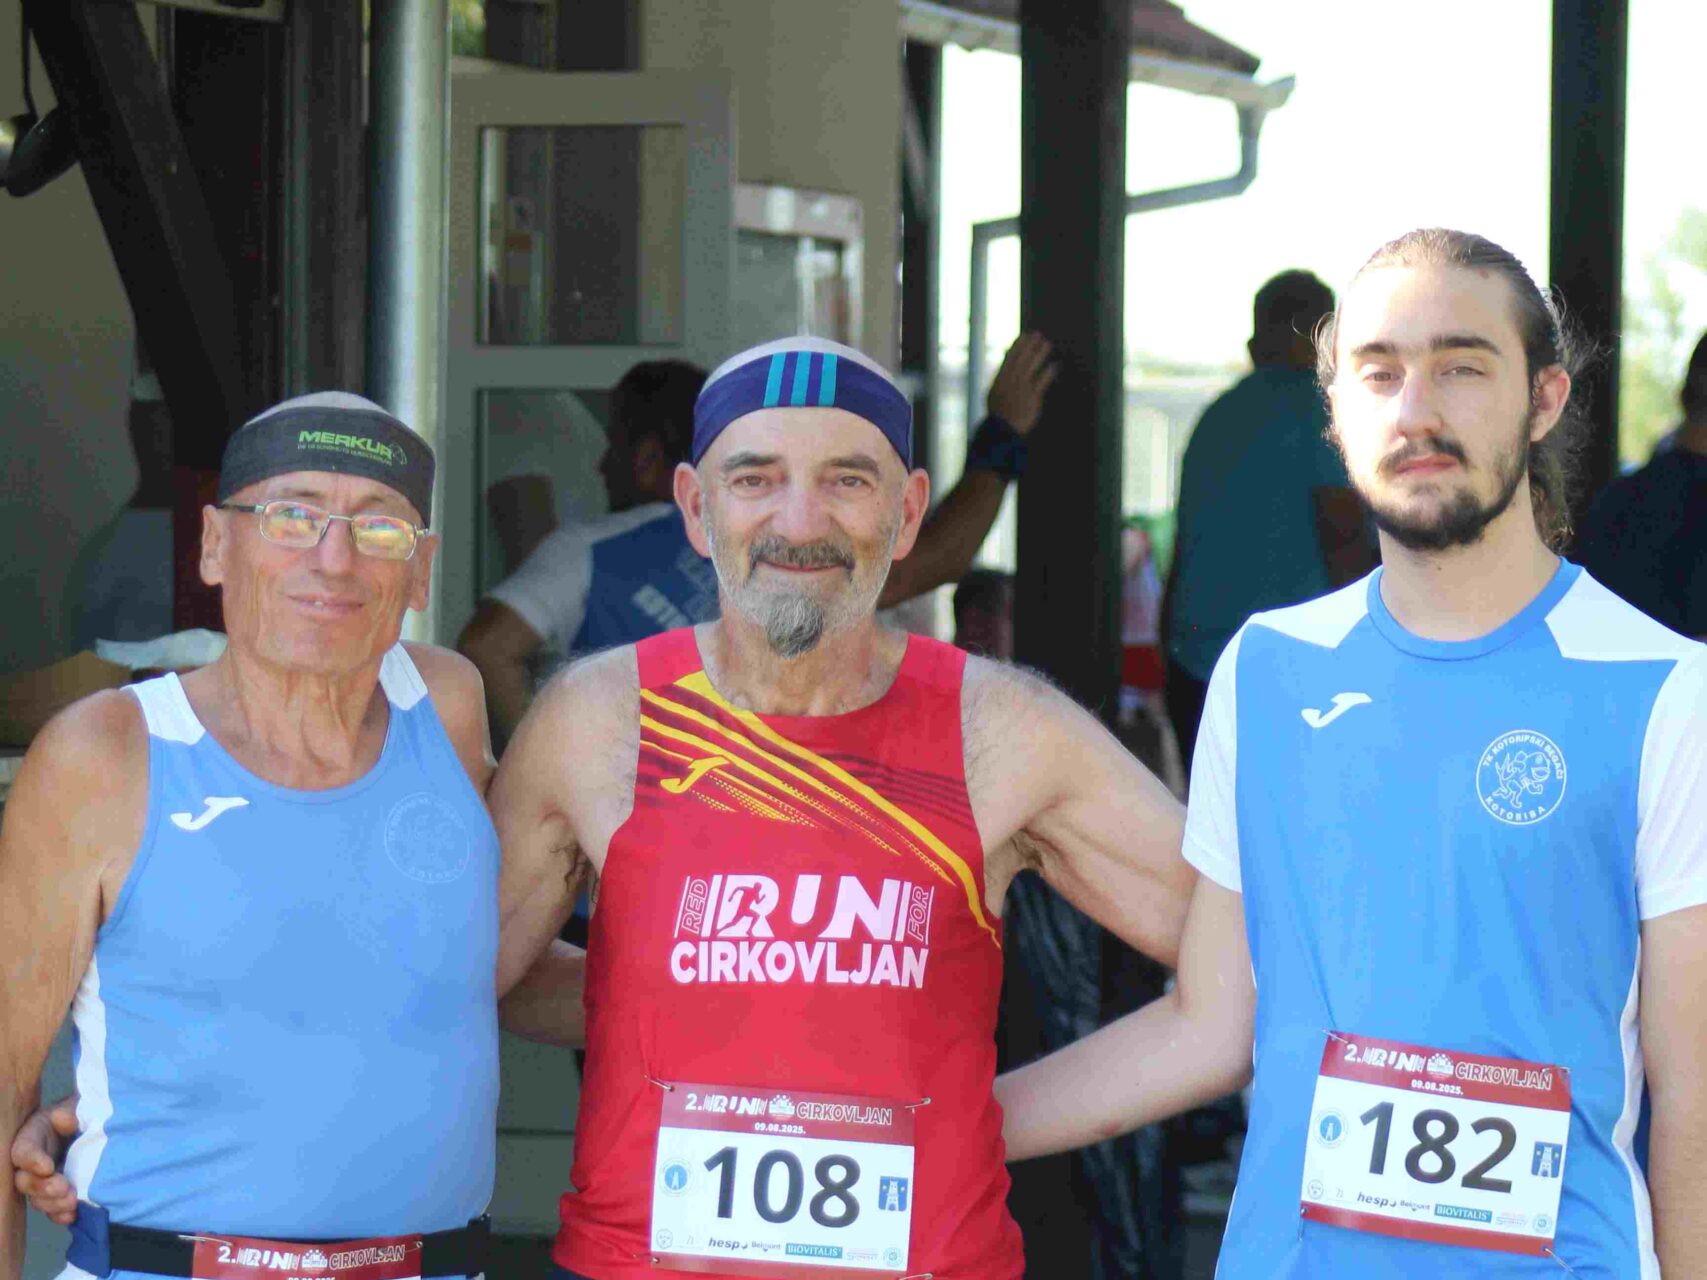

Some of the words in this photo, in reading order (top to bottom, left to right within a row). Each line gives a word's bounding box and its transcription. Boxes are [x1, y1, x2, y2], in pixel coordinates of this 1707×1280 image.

[299, 431, 393, 460] MERKUR
[681, 878, 709, 934] RED
[716, 874, 901, 940] RUN
[907, 885, 930, 941] FOR
[670, 940, 929, 989] CIRKOVLJAN
[1455, 1061, 1553, 1091] CIRKOVLJAN
[796, 1101, 893, 1126] CIRKOVLJAN
[1359, 1101, 1517, 1194] 182
[703, 1146, 861, 1229] 108
[1436, 1205, 1490, 1222] BIOVITALIS
[787, 1243, 841, 1257] BIOVITALIS
